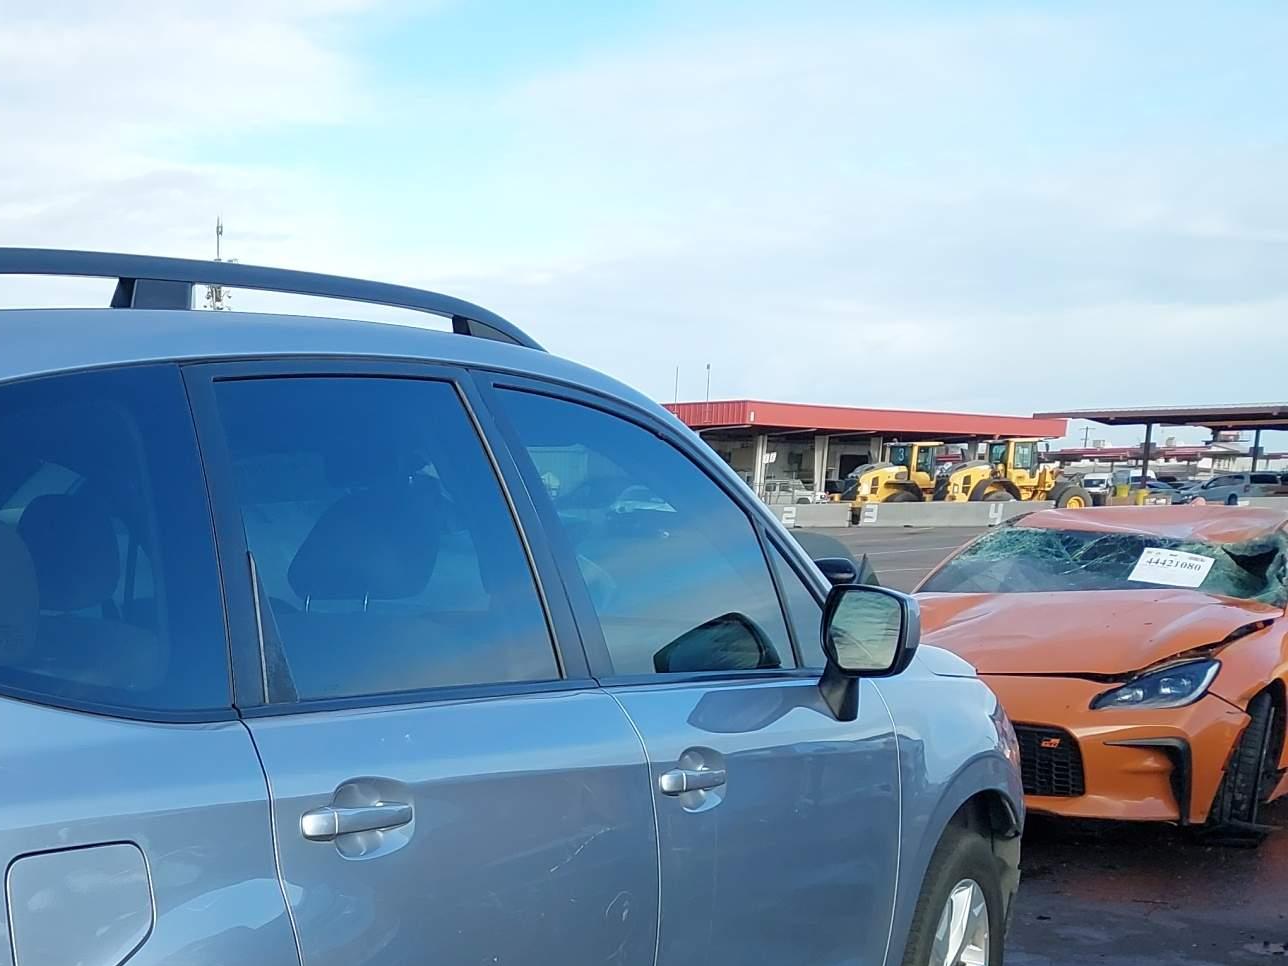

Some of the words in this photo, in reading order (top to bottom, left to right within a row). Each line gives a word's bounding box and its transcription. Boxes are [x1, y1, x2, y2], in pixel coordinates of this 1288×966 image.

[782, 506, 797, 524] 2
[863, 504, 879, 523] 3
[1146, 557, 1202, 571] 44421080
